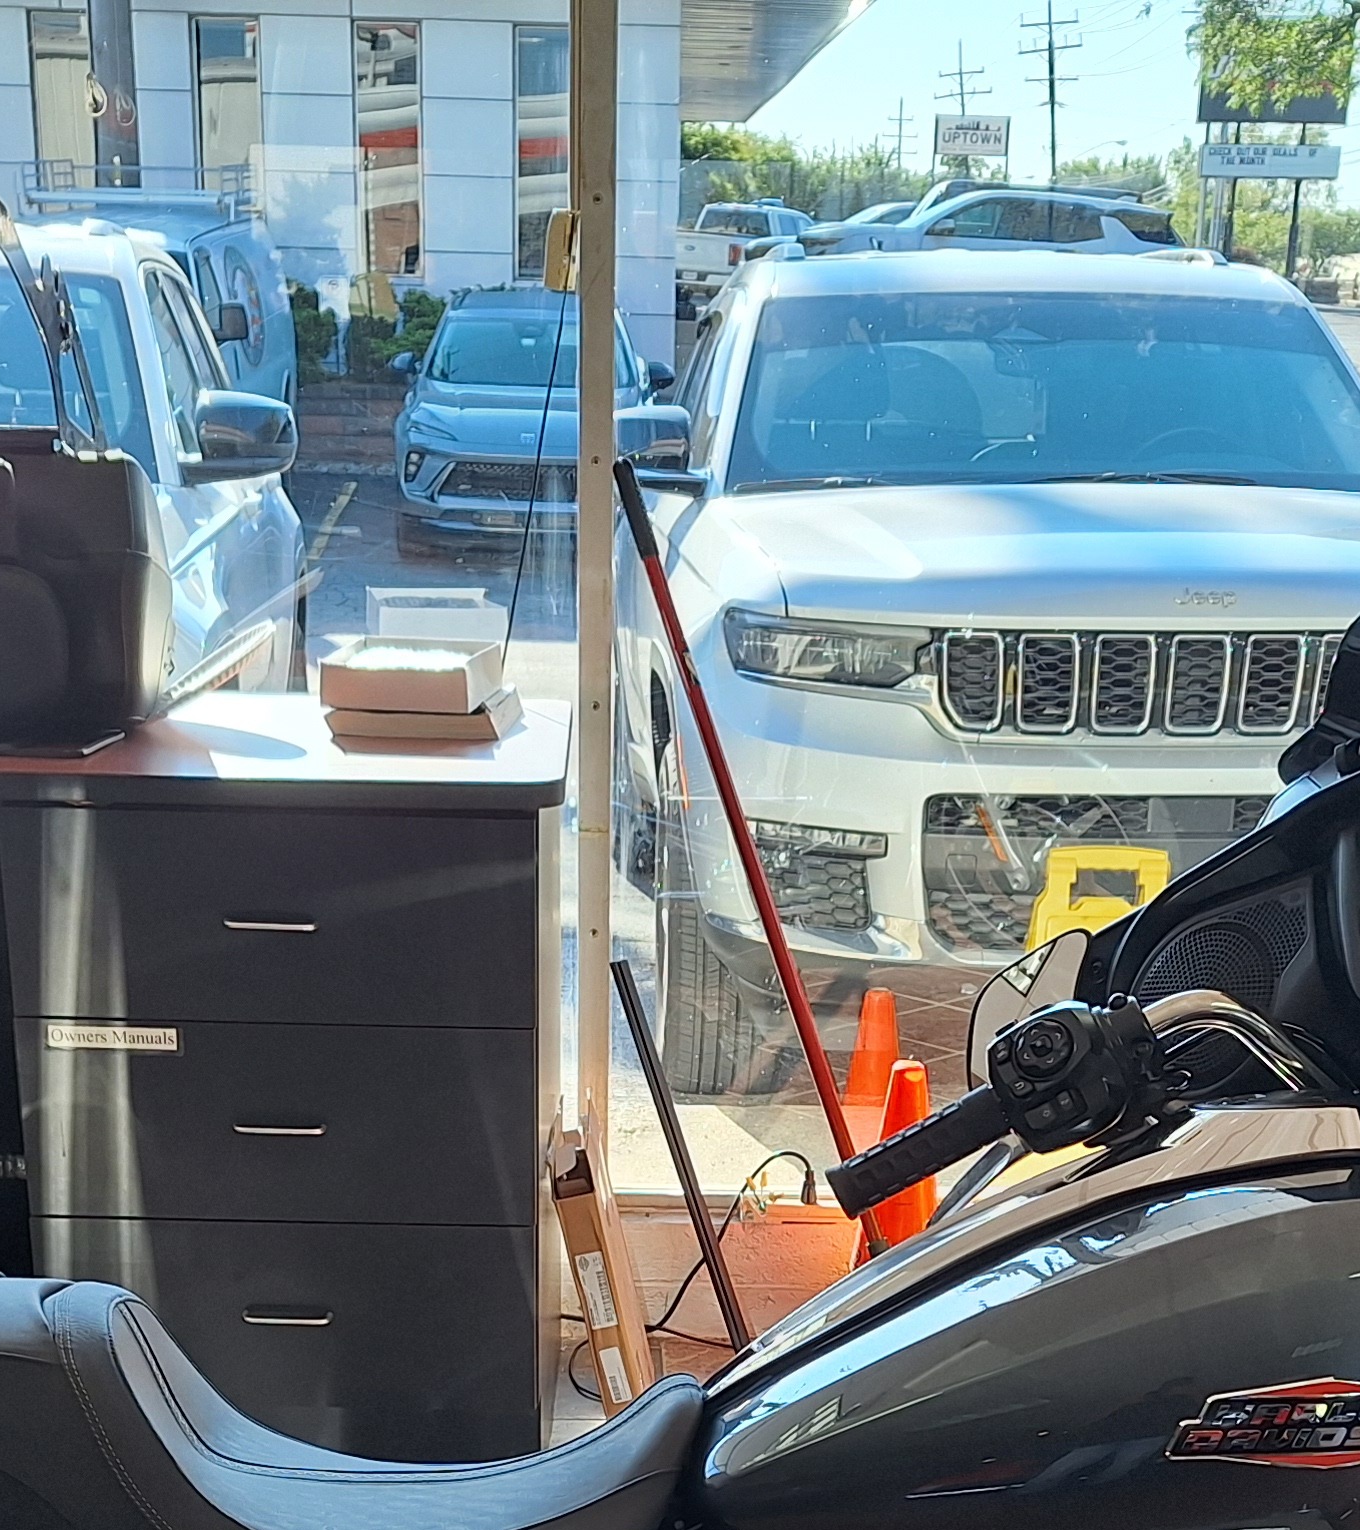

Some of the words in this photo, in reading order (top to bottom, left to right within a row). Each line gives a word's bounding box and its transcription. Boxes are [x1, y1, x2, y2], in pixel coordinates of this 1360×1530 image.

[942, 131, 1003, 145] UPTOWN
[1208, 147, 1232, 156] CHECK
[1236, 147, 1250, 156] OUT
[1253, 147, 1267, 156] OUR
[1273, 148, 1298, 157] DEALS
[1174, 587, 1237, 608] Jeep
[51, 1028, 107, 1043] Owners
[112, 1030, 175, 1046] Manuals
